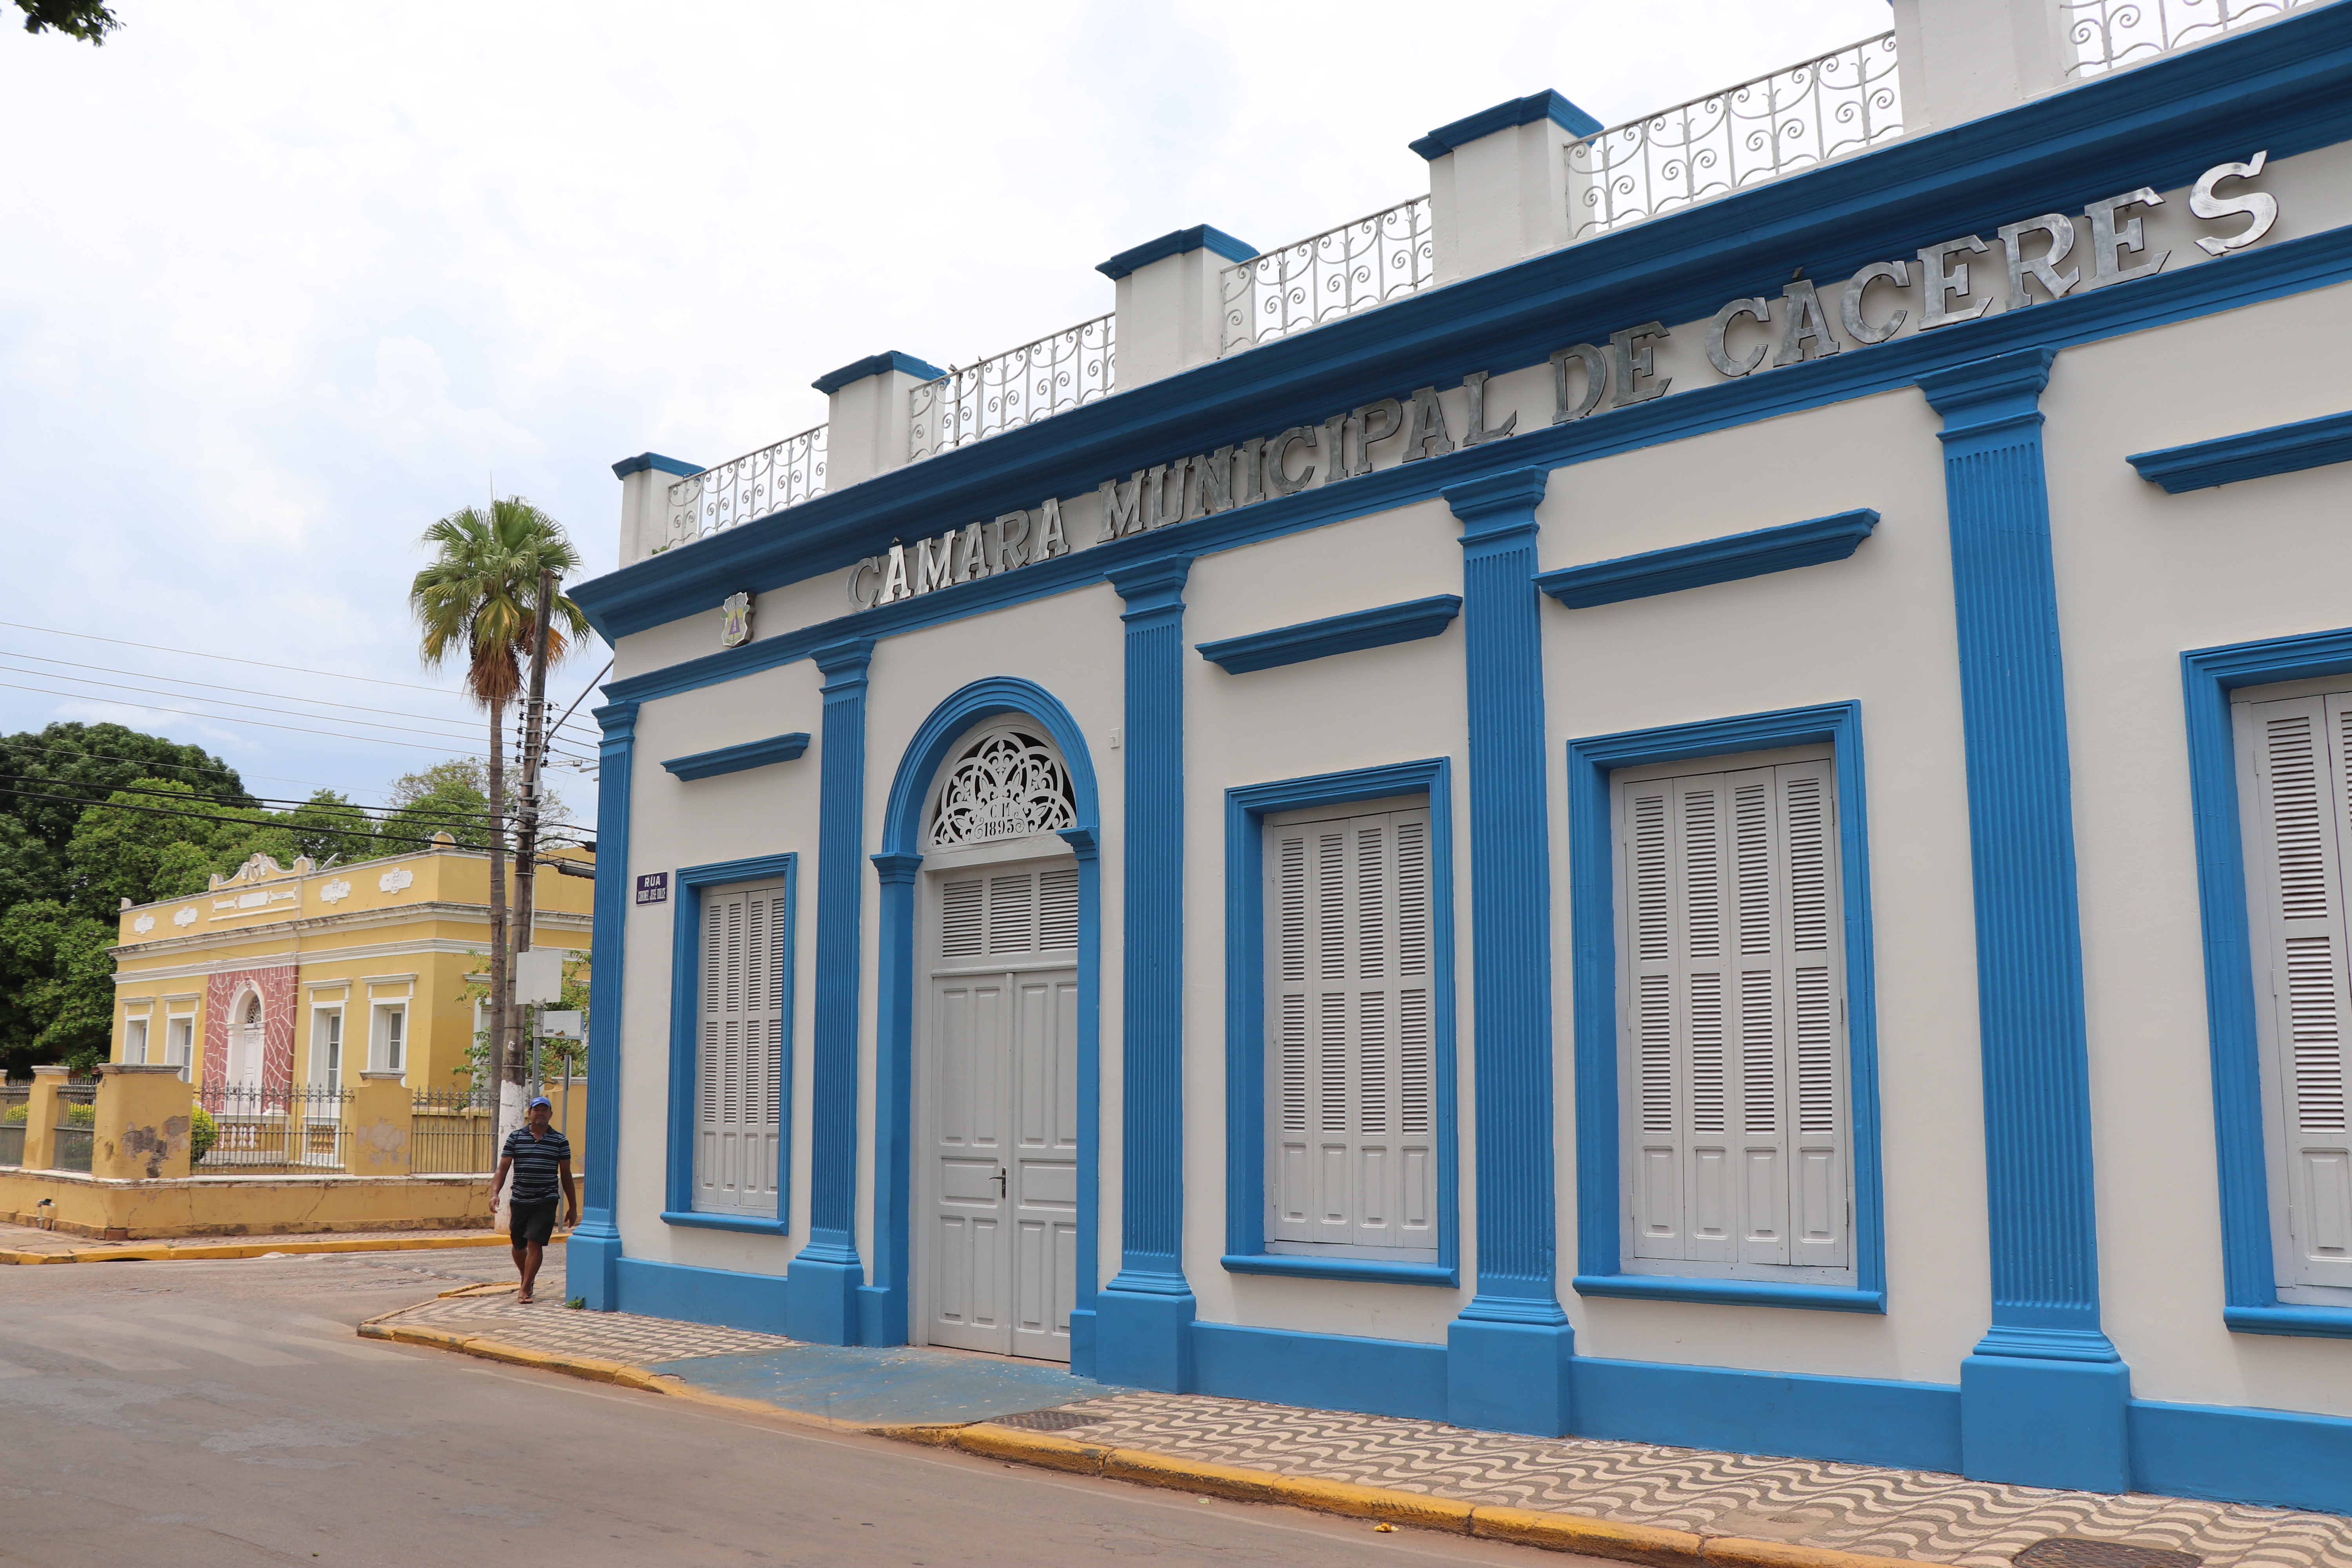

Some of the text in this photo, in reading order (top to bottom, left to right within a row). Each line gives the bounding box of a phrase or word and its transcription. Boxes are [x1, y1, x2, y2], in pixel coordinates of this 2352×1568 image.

[846, 150, 2279, 612] CÂMARA MUNICIPAL DE CÁCERES
[984, 819, 1014, 837] 1893
[644, 875, 661, 887] RUA
